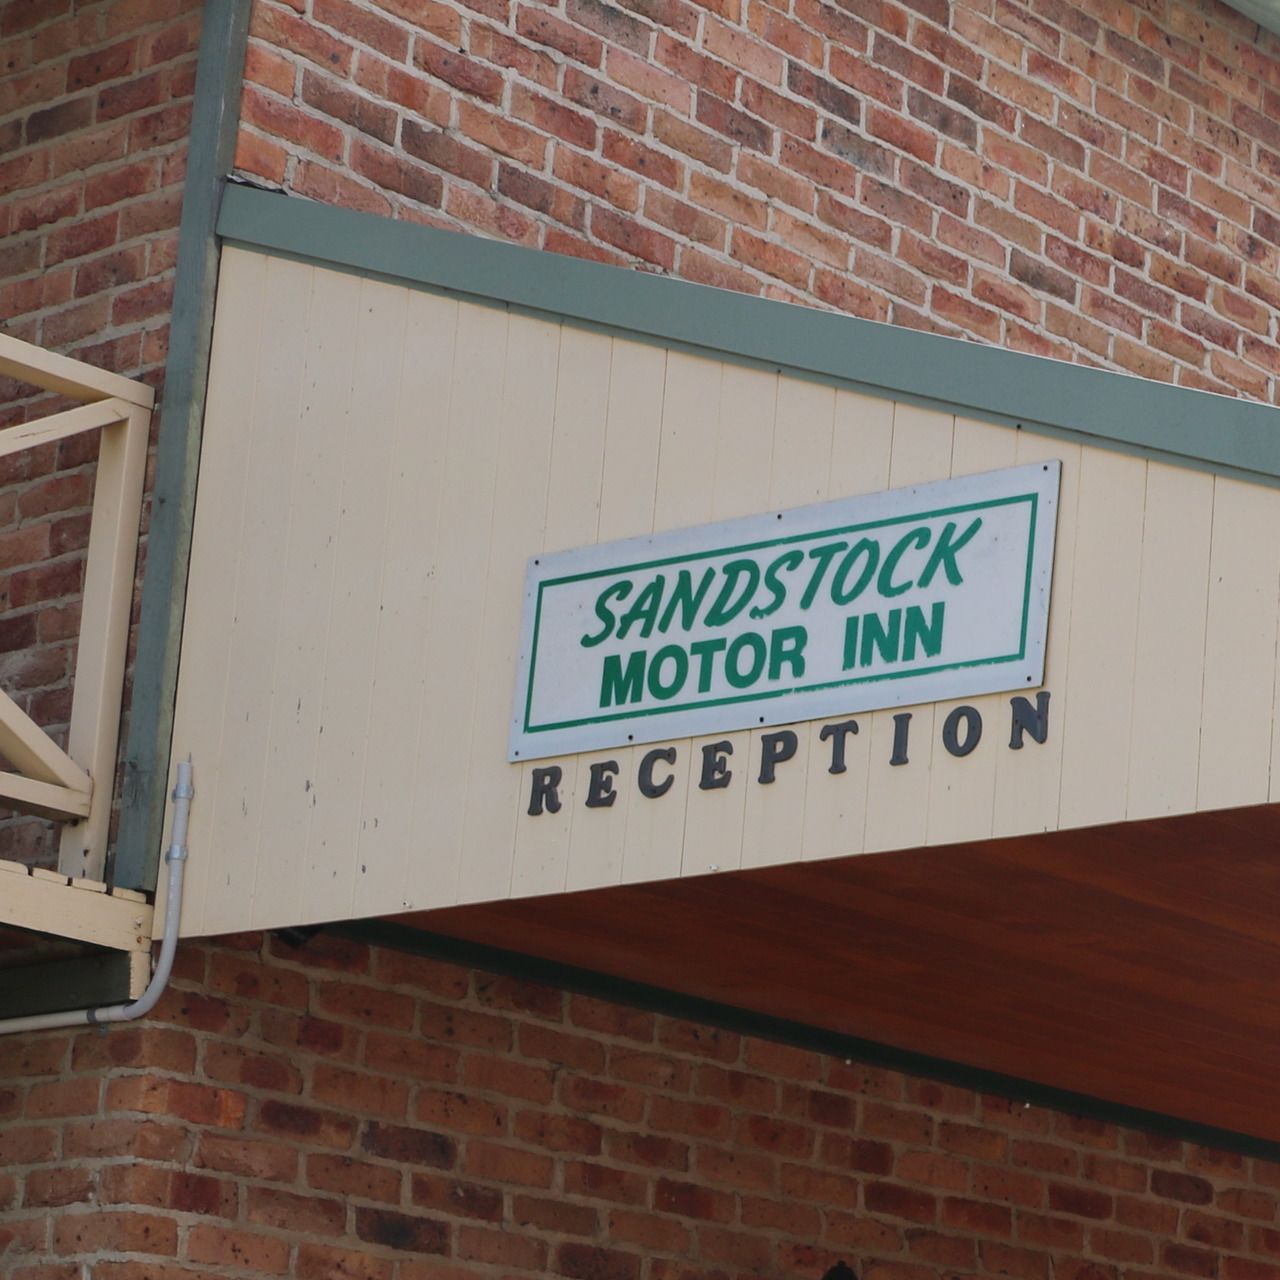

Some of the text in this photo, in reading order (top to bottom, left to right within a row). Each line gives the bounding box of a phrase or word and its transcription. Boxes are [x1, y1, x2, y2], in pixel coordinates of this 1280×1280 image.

[580, 517, 982, 647] SANDSTOCK
[599, 601, 946, 708] MOTOR INN
[527, 691, 1051, 816] RECEPTION
